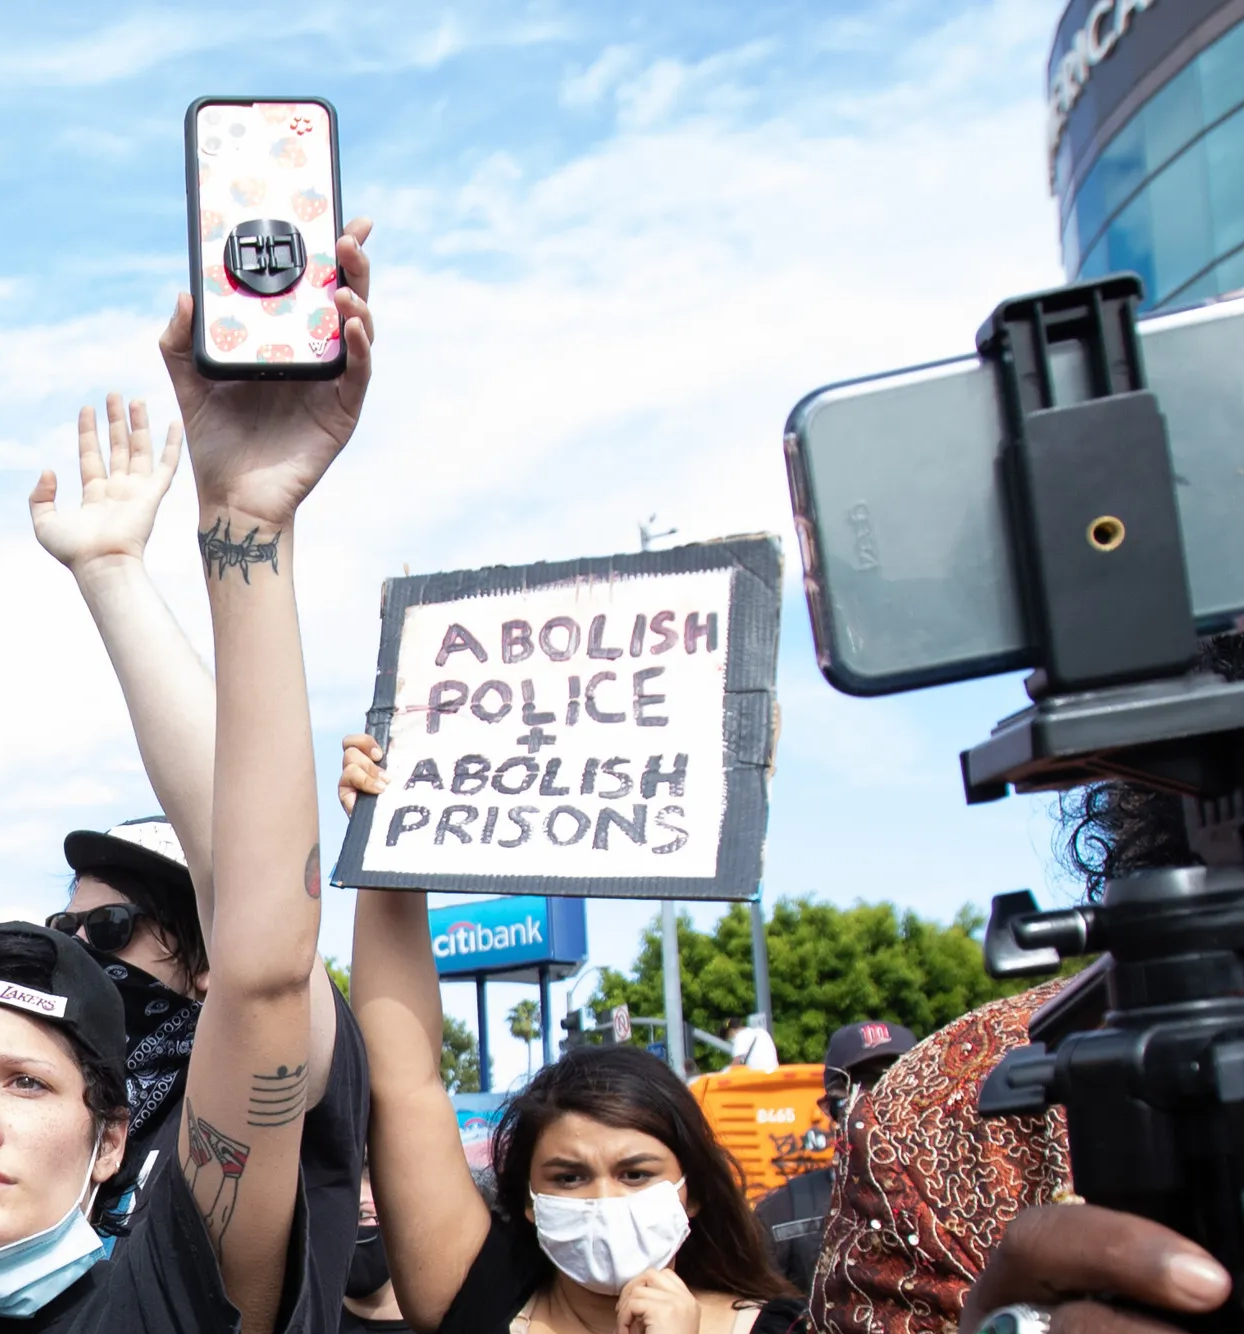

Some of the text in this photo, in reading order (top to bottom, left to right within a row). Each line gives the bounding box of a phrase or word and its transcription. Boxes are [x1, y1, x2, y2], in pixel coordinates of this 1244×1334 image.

[434, 610, 719, 667] ABOLISH
[426, 666, 670, 735] POLICE
[516, 727, 557, 754] +
[403, 752, 689, 800] ABOLISH
[385, 802, 690, 855] PRISONS
[432, 915, 543, 958] citibank
